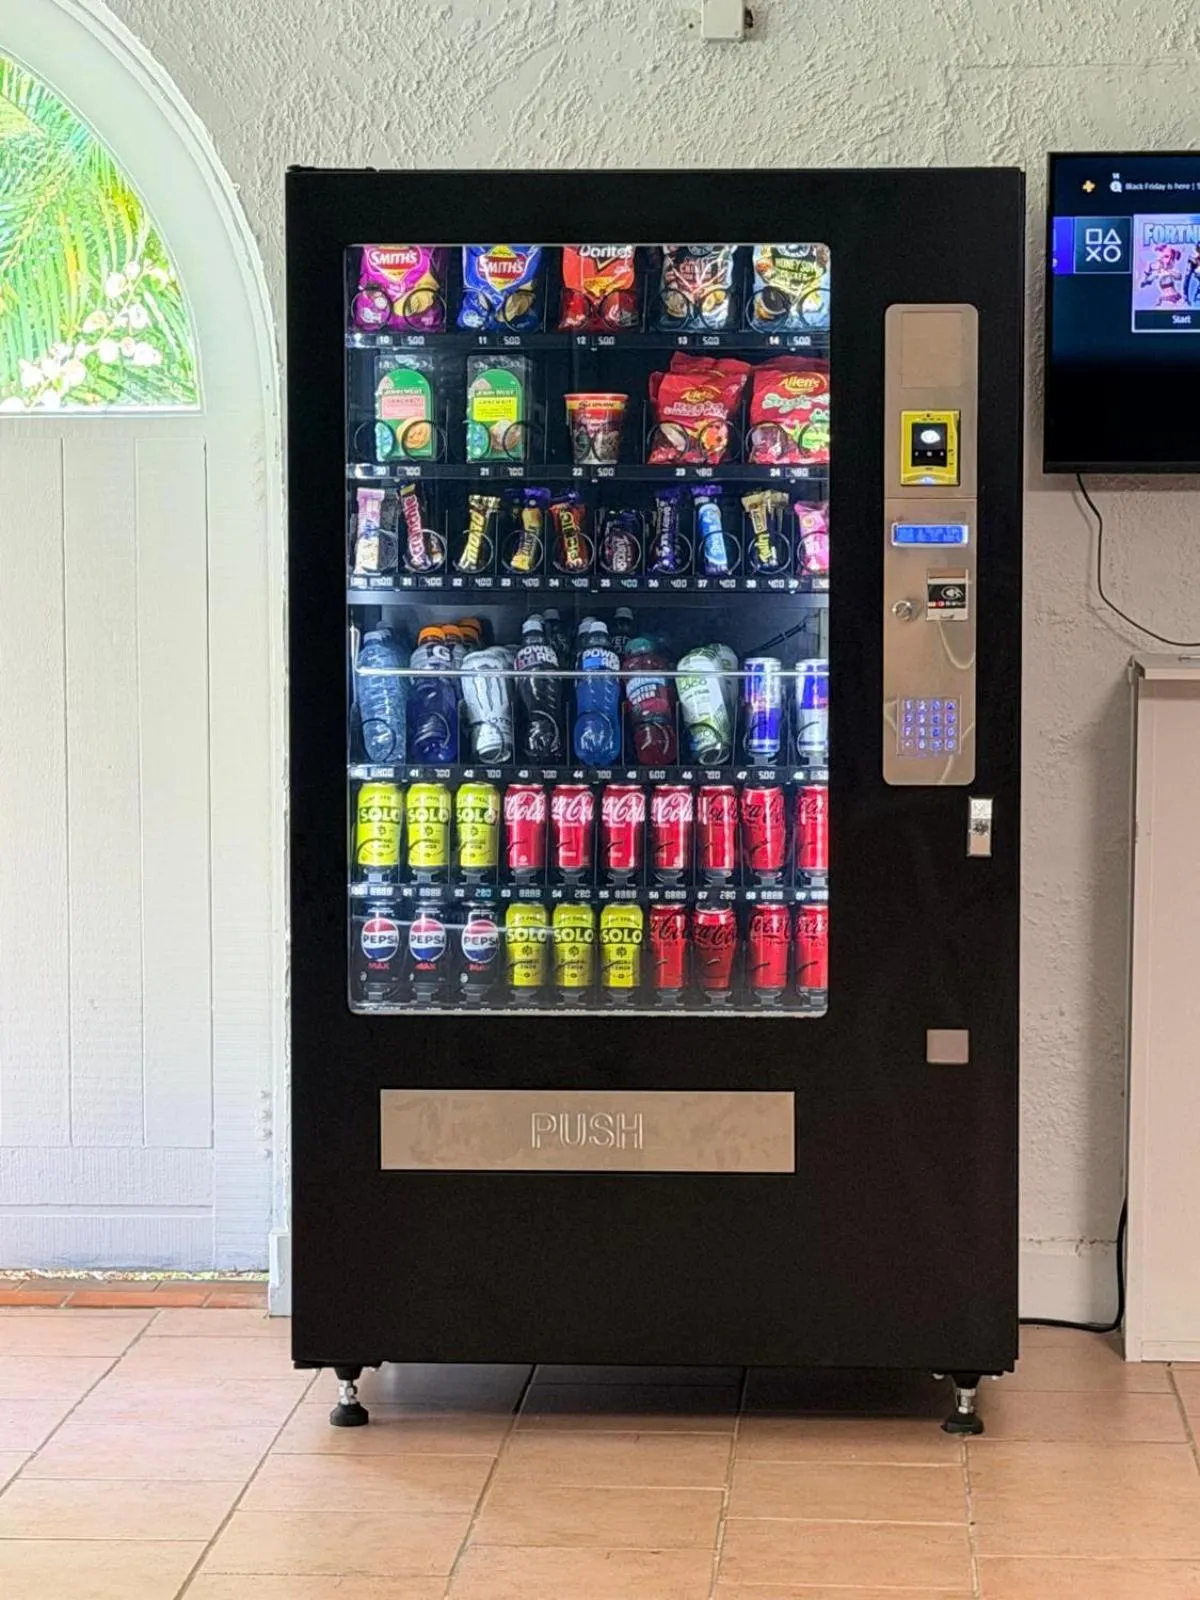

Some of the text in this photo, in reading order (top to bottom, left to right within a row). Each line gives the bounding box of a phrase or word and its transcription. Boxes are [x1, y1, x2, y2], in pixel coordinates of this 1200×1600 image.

[1125, 182, 1143, 190] Black
[1144, 182, 1166, 191] Friday
[1174, 182, 1190, 190] here
[1172, 314, 1192, 324] Start
[736, 771, 748, 780] 47
[360, 807, 400, 823] SOLO
[406, 807, 450, 823] SOLO
[456, 807, 496, 824] SOLO
[362, 934, 398, 945] PEPSI
[410, 934, 445, 945] PEPSI
[463, 935, 498, 947] PEPSI
[506, 927, 547, 943] SOLO
[553, 928, 594, 944] SOLO
[600, 928, 642, 945] SOLO
[530, 1112, 645, 1150] PUSH
